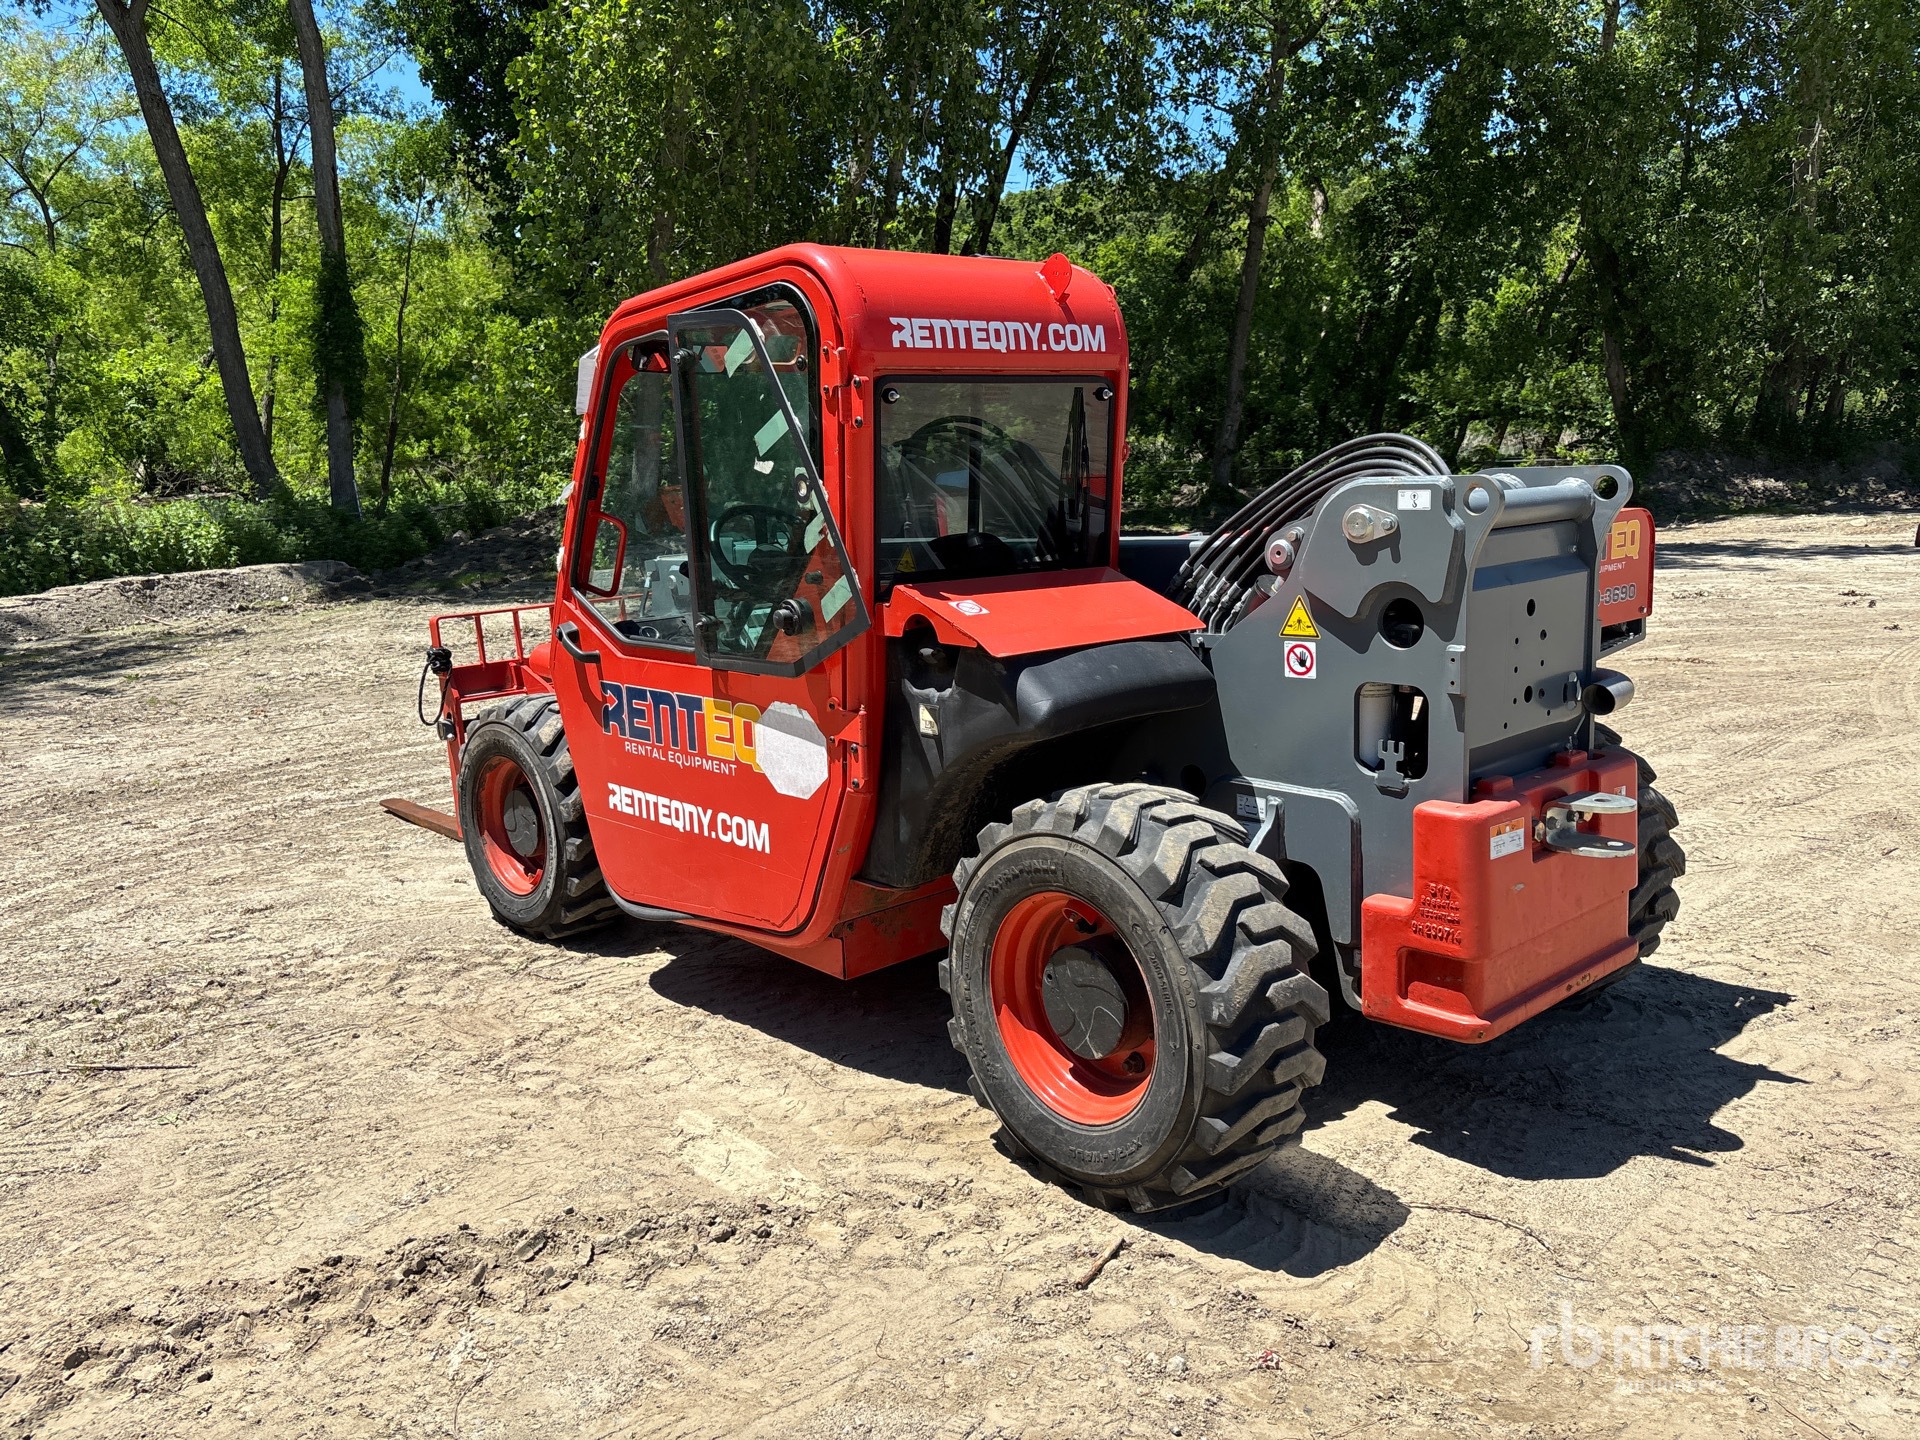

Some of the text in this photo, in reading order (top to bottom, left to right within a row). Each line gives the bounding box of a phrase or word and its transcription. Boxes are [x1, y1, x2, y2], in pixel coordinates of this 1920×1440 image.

[889, 317, 1106, 353] RENTEQNY.COM
[1598, 582, 1637, 607] -3690
[624, 741, 738, 777] RENTAL EQUIPMENT
[607, 782, 771, 855] RENTEQNY.COM
